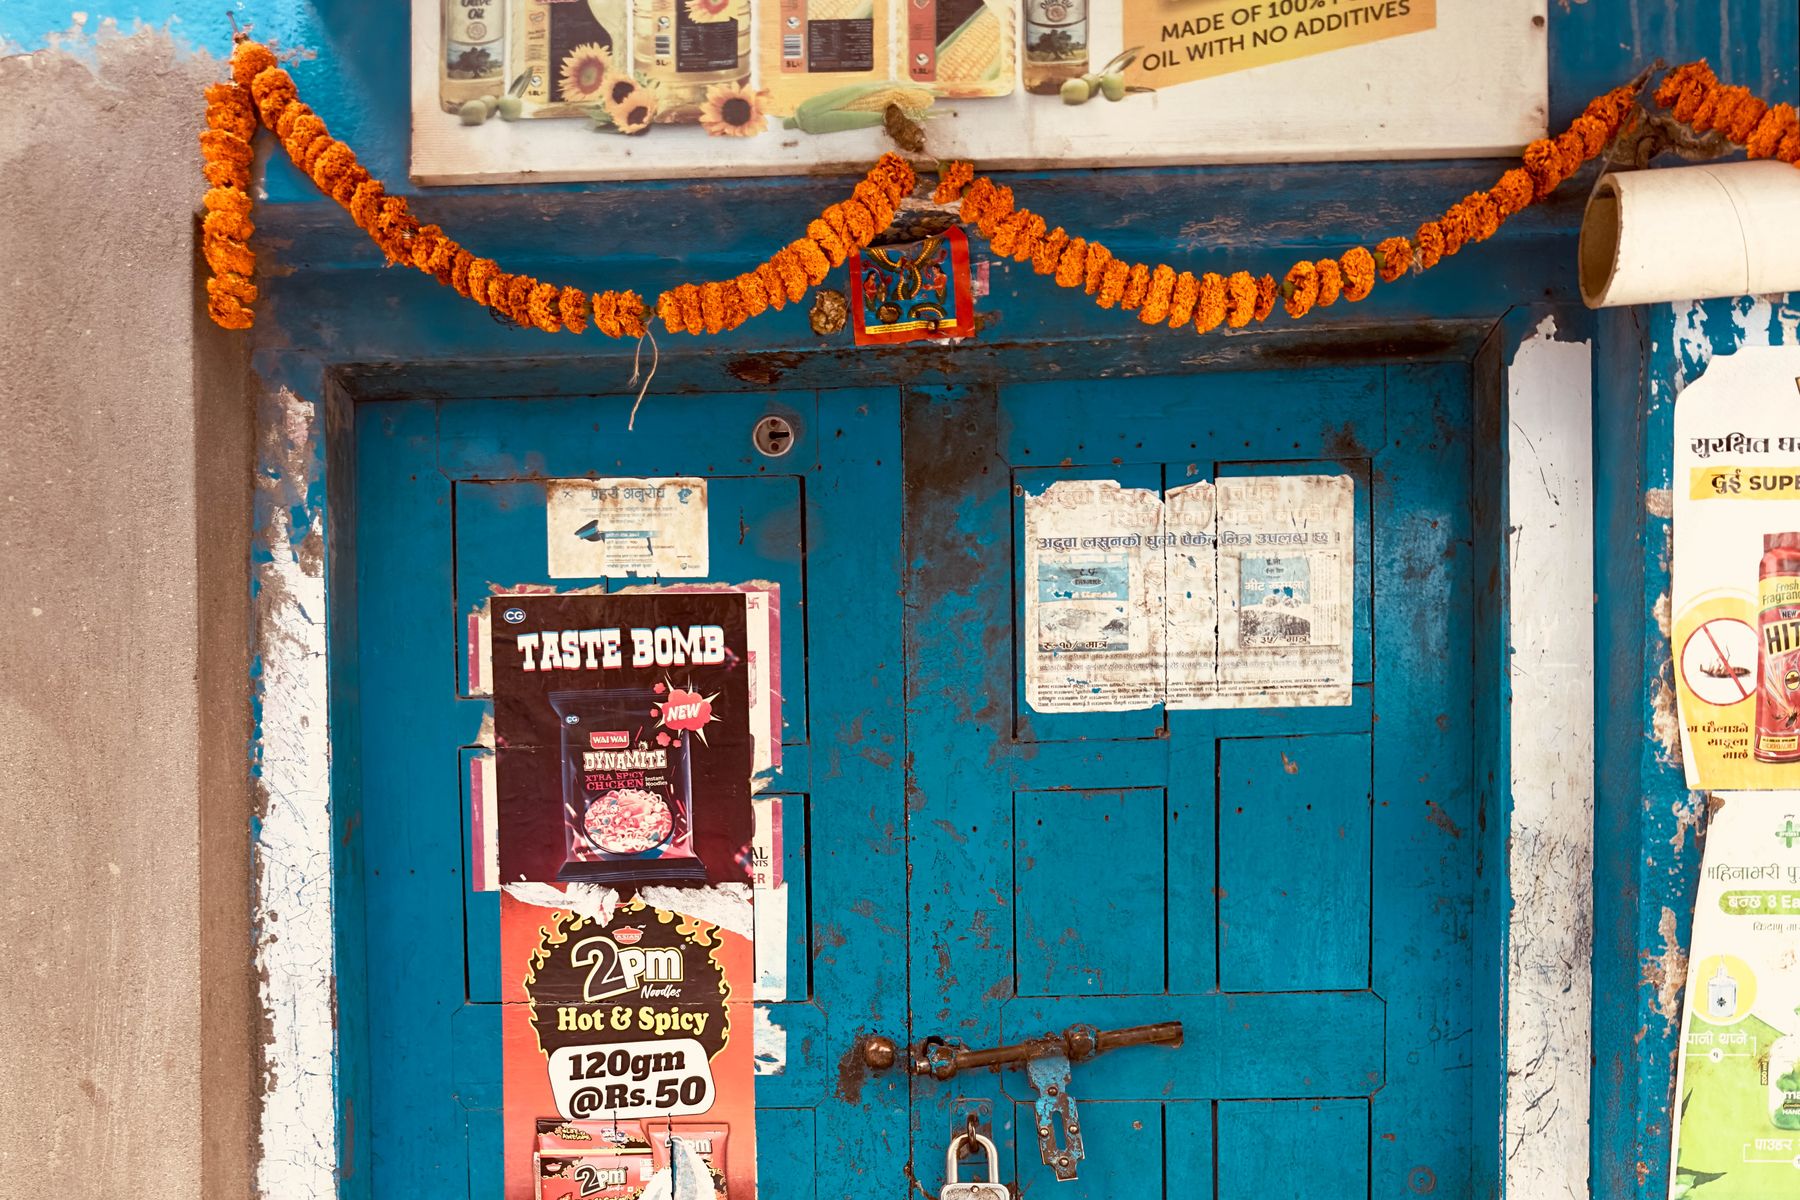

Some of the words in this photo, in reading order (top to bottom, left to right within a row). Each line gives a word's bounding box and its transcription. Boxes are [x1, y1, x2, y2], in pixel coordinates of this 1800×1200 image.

[1142, 48, 1181, 72] OIL
[1186, 34, 1245, 62] WITH
[1252, 25, 1288, 48] NO
[1294, 0, 1411, 40] ADDITIVES
[1161, 13, 1225, 42] MADE
[1231, 6, 1262, 27] OF
[1690, 431, 1770, 459] सुरक्षित
[1777, 436, 1800, 453] घ
[1711, 467, 1742, 495] दुई
[1037, 535, 1078, 554] अदुवा
[504, 610, 525, 622] CG
[1781, 609, 1797, 619] NEW
[517, 627, 623, 673] TASTE
[630, 624, 726, 669] BOMB
[1765, 621, 1800, 656] HIT
[667, 702, 701, 722] NEW
[592, 736, 610, 744] WAI
[610, 735, 627, 743] WAI
[583, 748, 668, 772] DYNAMITE
[585, 774, 613, 782] XTRA
[616, 771, 645, 780] SPICY
[586, 778, 644, 791] CHICKEN
[570, 936, 684, 1002] 2pm
[640, 984, 682, 999] Noodles
[557, 1007, 605, 1031] Hot
[610, 1006, 633, 1031] &
[638, 1006, 709, 1036] Spicy
[568, 1049, 686, 1082] 120gm
[574, 1164, 628, 1198] 2pm
